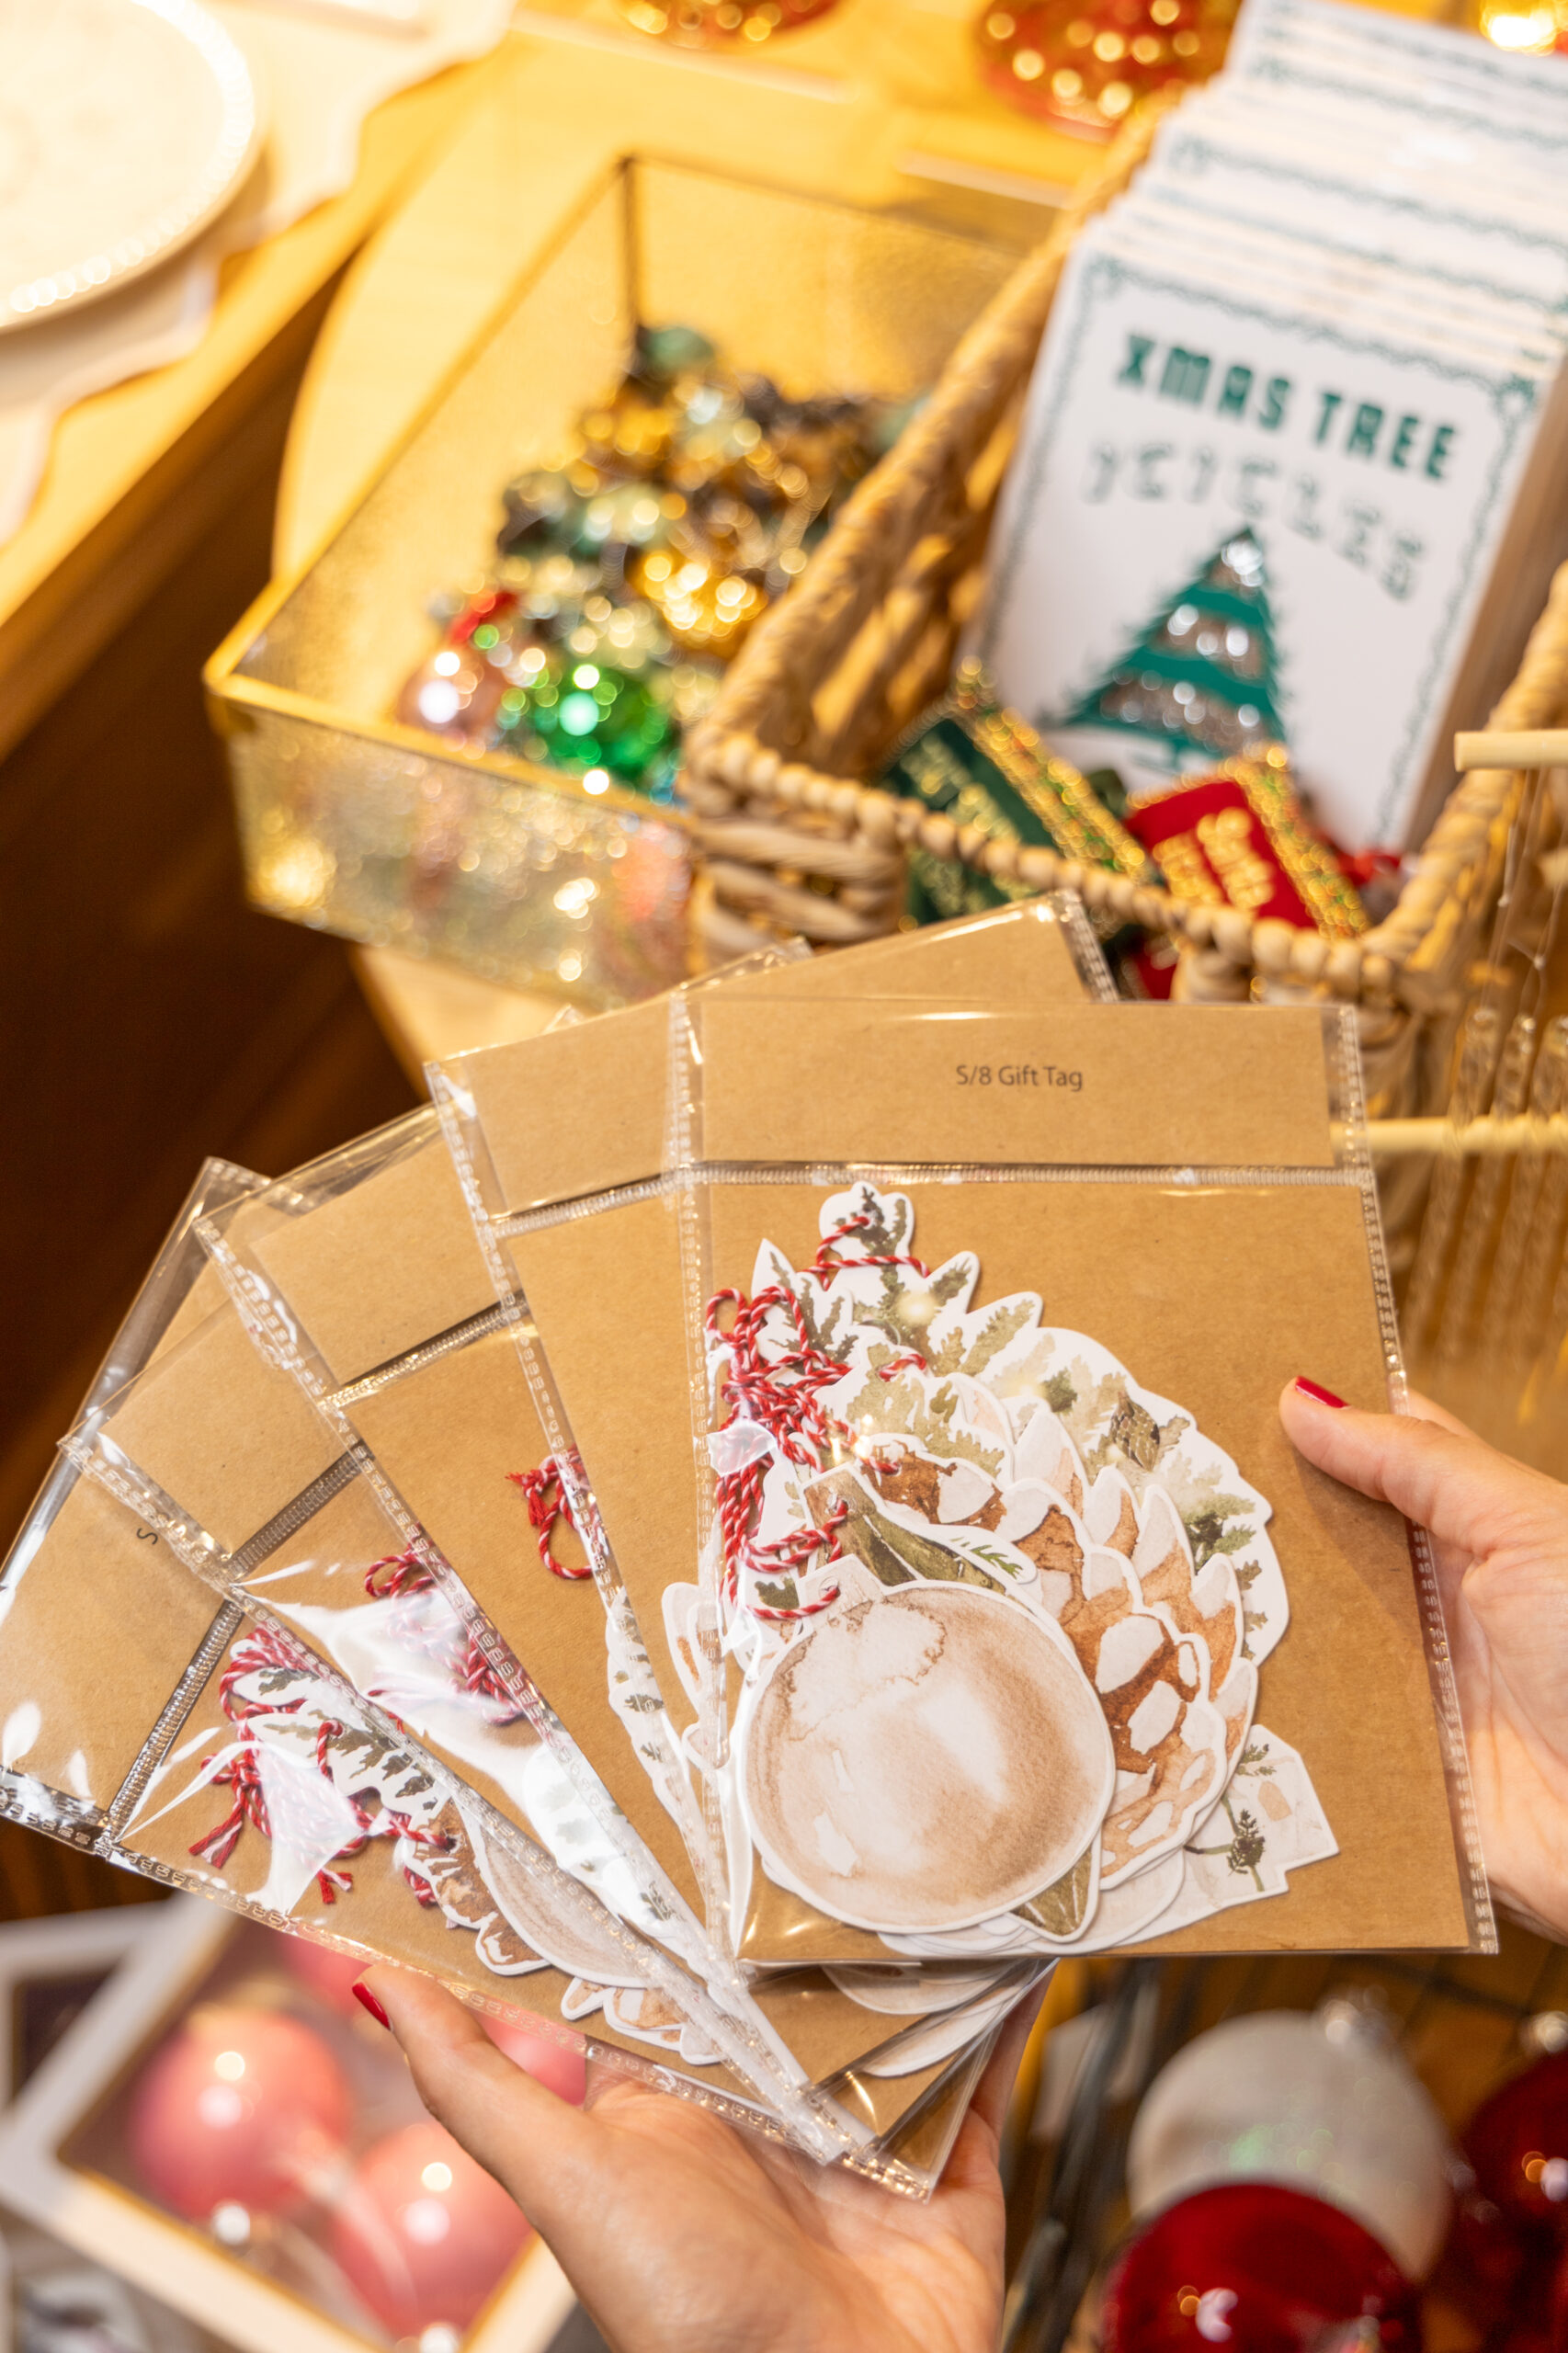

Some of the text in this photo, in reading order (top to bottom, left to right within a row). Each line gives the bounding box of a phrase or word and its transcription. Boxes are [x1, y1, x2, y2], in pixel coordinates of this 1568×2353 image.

[1118, 334, 1458, 480] XMAS TREE
[956, 1064, 1083, 1092] S/8 Gift Tag
